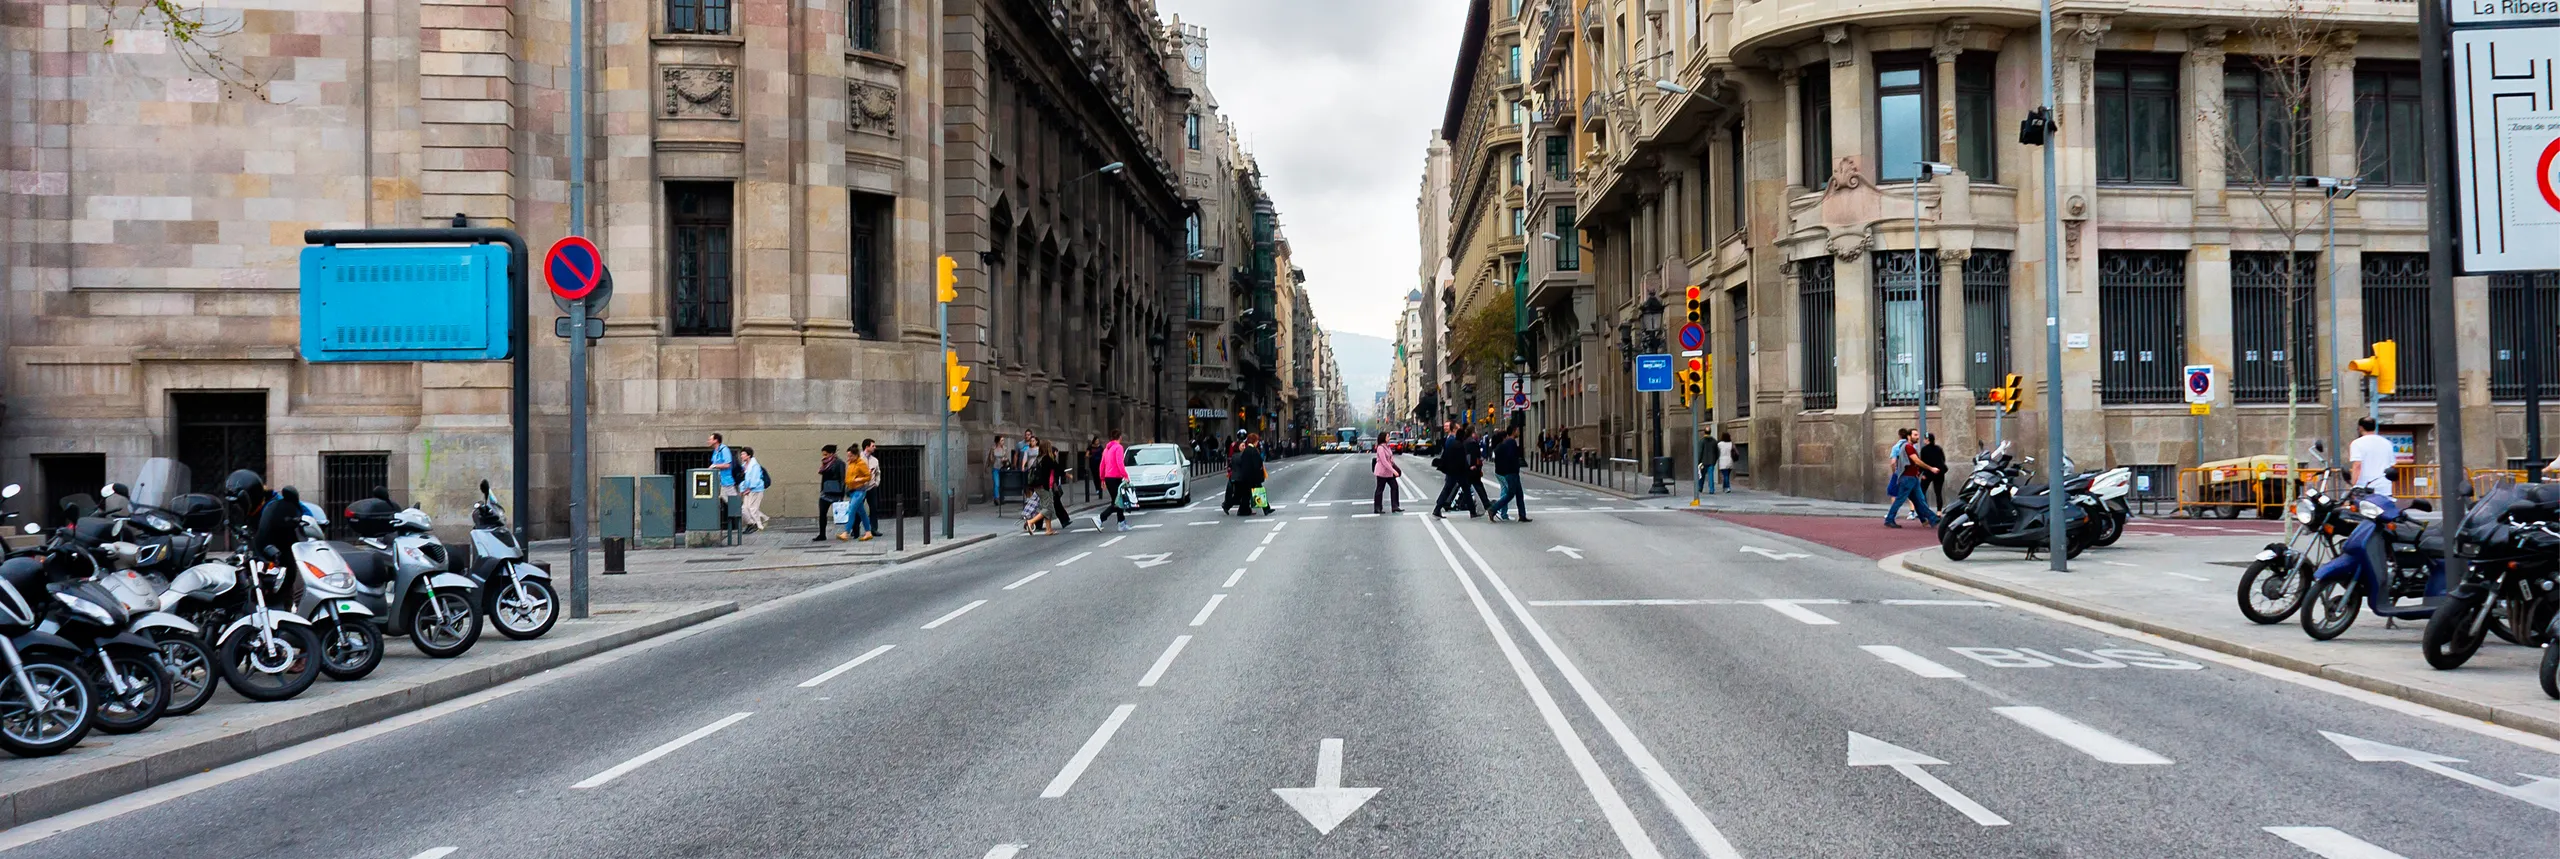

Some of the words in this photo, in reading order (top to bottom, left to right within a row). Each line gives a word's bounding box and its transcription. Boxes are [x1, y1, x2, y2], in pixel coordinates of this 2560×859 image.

[2473, 1, 2495, 15] La
[2502, 0, 2558, 14] Ribera
[2512, 123, 2532, 131] Zona
[1648, 376, 1662, 384] taxi
[1194, 408, 1214, 418] HOTEL
[1947, 646, 2205, 671] BUS
